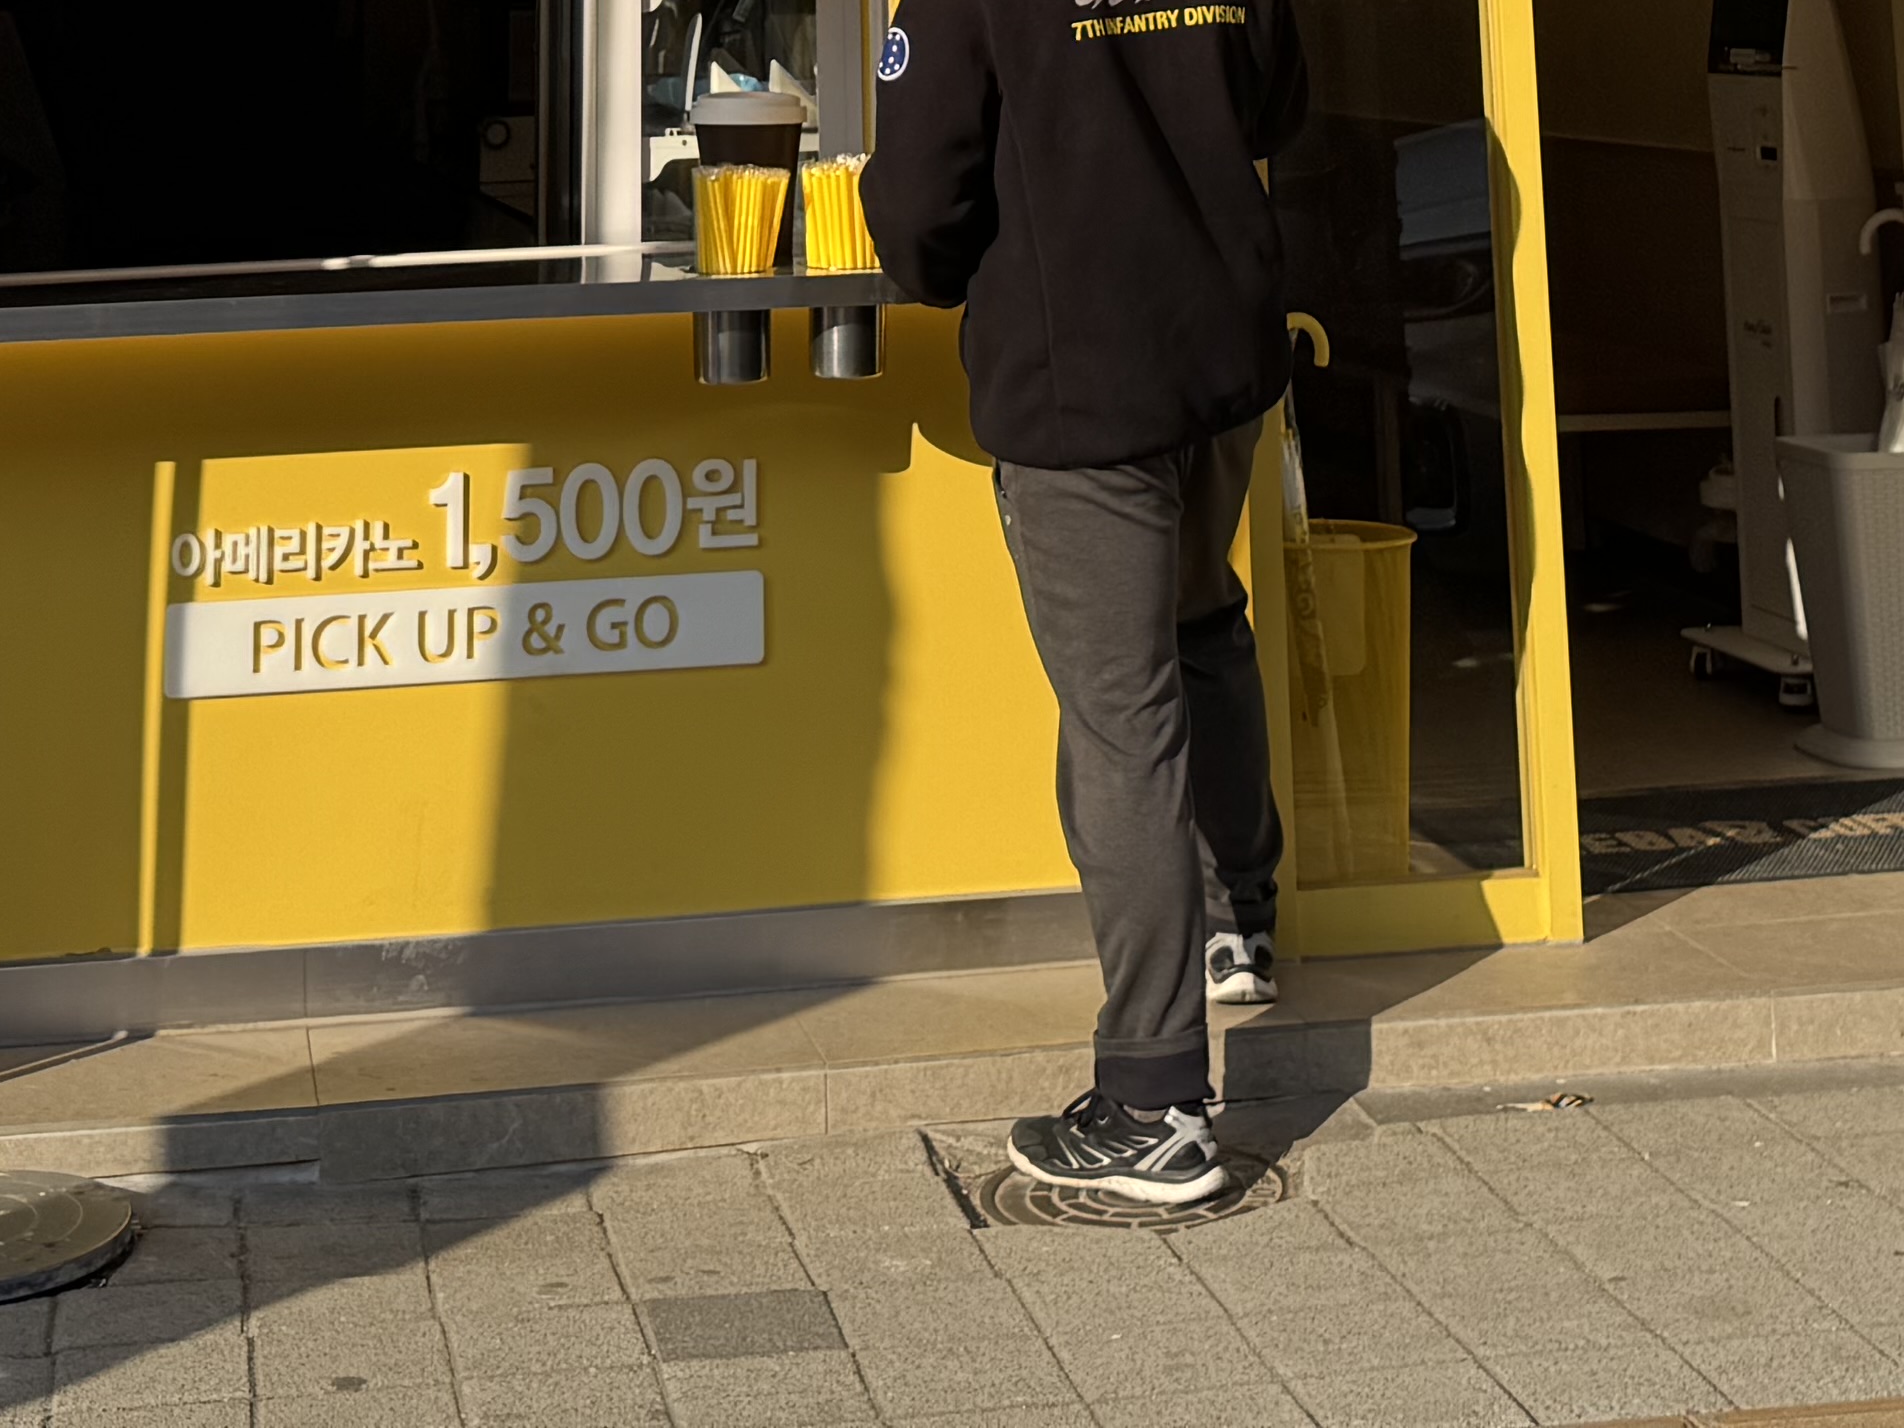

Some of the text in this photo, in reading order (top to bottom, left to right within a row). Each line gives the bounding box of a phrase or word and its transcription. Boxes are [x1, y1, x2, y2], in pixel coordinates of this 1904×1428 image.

[1070, 5, 1246, 42] 7TH INFANTRY DIVISION
[171, 457, 761, 588] 아메리카노 1,500원
[251, 594, 680, 675] PICK UP & GO
